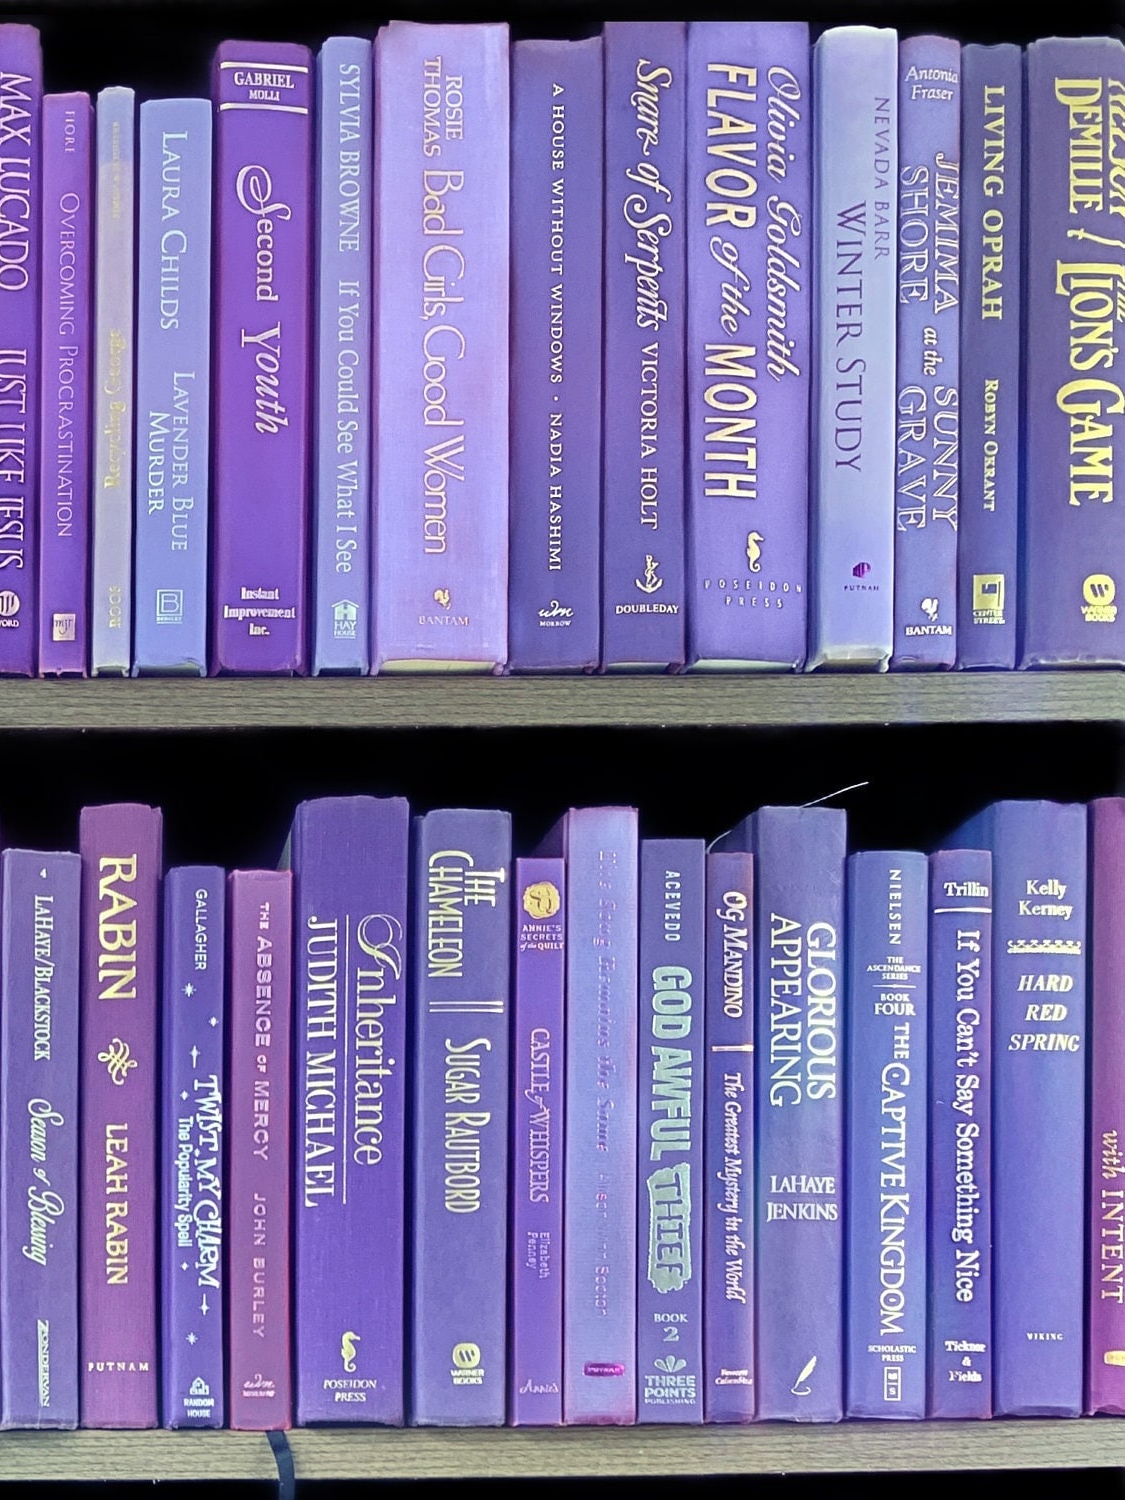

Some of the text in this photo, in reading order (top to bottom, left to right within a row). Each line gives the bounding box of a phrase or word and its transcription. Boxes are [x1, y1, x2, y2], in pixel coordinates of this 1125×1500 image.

[234, 71, 295, 89] GABRIEL
[249, 89, 280, 102] MOLLI
[548, 82, 566, 384] A HOUSE WITHOUT WINDOWS
[981, 85, 1005, 321] LIVING OPRAH
[834, 200, 867, 472] WINTER STUDY
[640, 342, 660, 531] VICTORIA HOLT
[548, 413, 564, 572] NADIA HASHIMI
[614, 602, 679, 616] DOUBLEDAY
[98, 853, 138, 1000] RABIN
[888, 869, 902, 945] NIELSEN
[943, 881, 989, 898] Trillin
[1018, 900, 1074, 921] Kerney
[1026, 878, 1068, 900] Kelly
[769, 911, 802, 1107] APPEARING
[806, 921, 837, 1100] GLORIOUS
[1017, 974, 1074, 993] HARD
[1024, 1003, 1068, 1022] RED
[304, 915, 338, 1208] JUDITH MICHAEL
[1008, 1033, 1081, 1053] SPRING
[950, 929, 981, 1302] If You Can't Say Something Nice
[105, 1122, 129, 1285] LEAH RABIN
[766, 1201, 838, 1223] JENKINS
[879, 1021, 911, 1337] THE CAPTIVE KINGDOM
[88, 1361, 149, 1372] PUTNAM
[1025, 1331, 1064, 1341] VIKING
